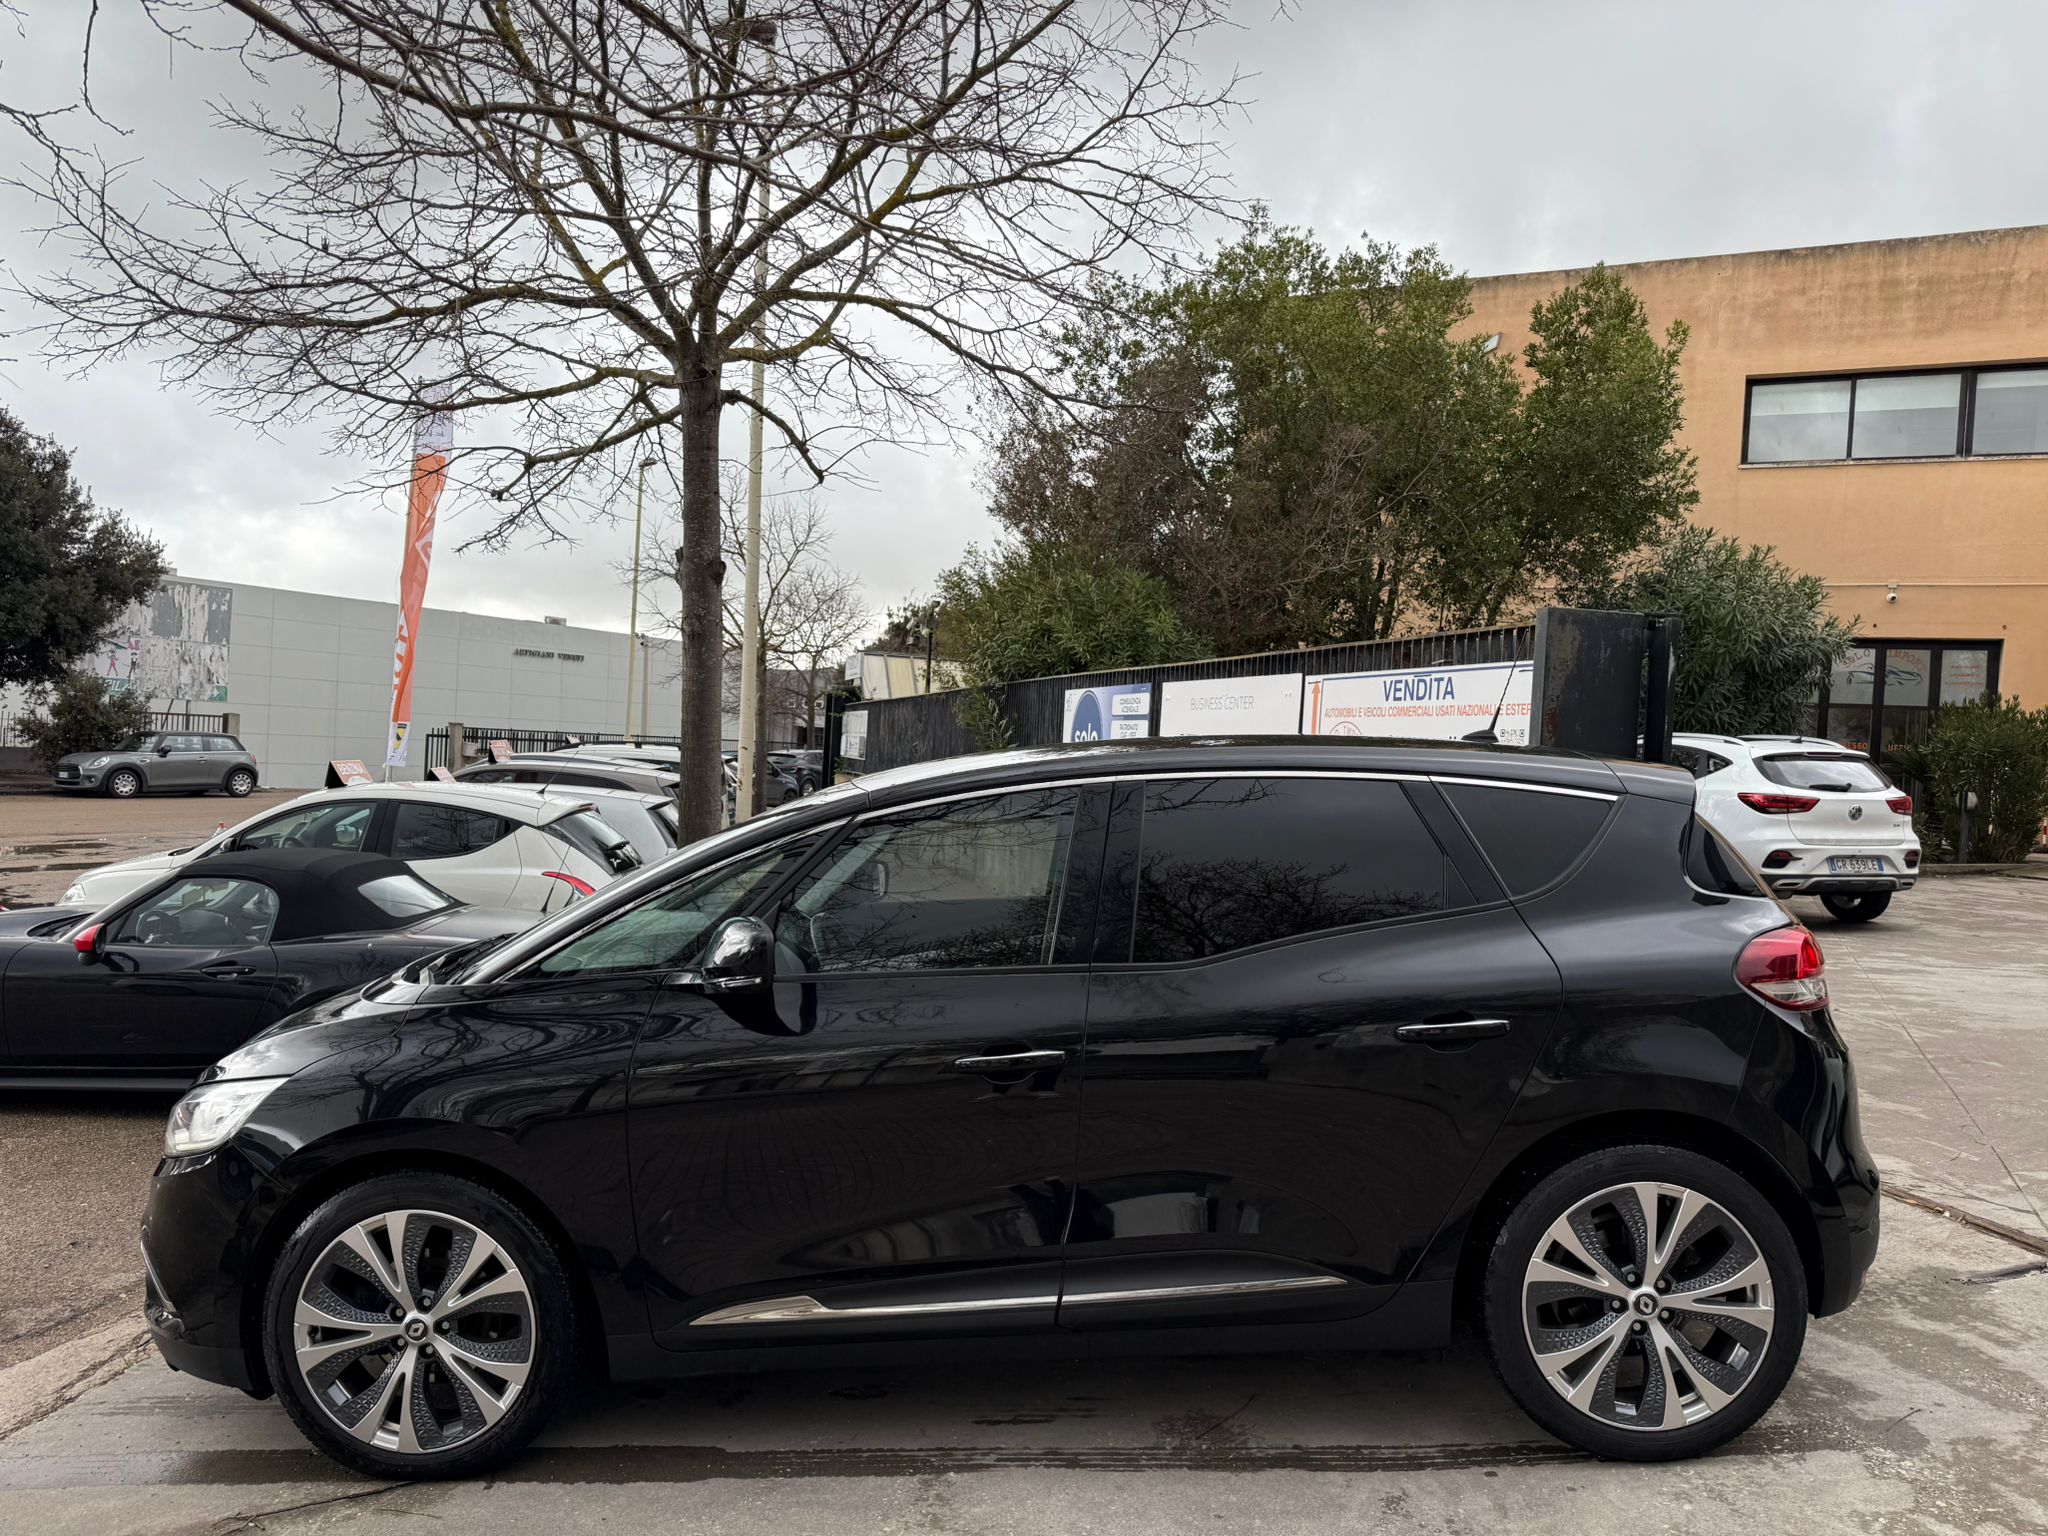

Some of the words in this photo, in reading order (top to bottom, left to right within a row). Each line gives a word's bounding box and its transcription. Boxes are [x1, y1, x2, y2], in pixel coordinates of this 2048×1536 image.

[1384, 677, 1455, 702] VENDITA
[1190, 697, 1223, 711] BUSINESS
[1224, 696, 1255, 710] CENTER
[1324, 707, 1358, 718] AUTOMOBILI
[1363, 706, 1387, 718] VEICOLI
[1388, 705, 1434, 718] COMMERCIALI
[1435, 705, 1455, 717] USATI
